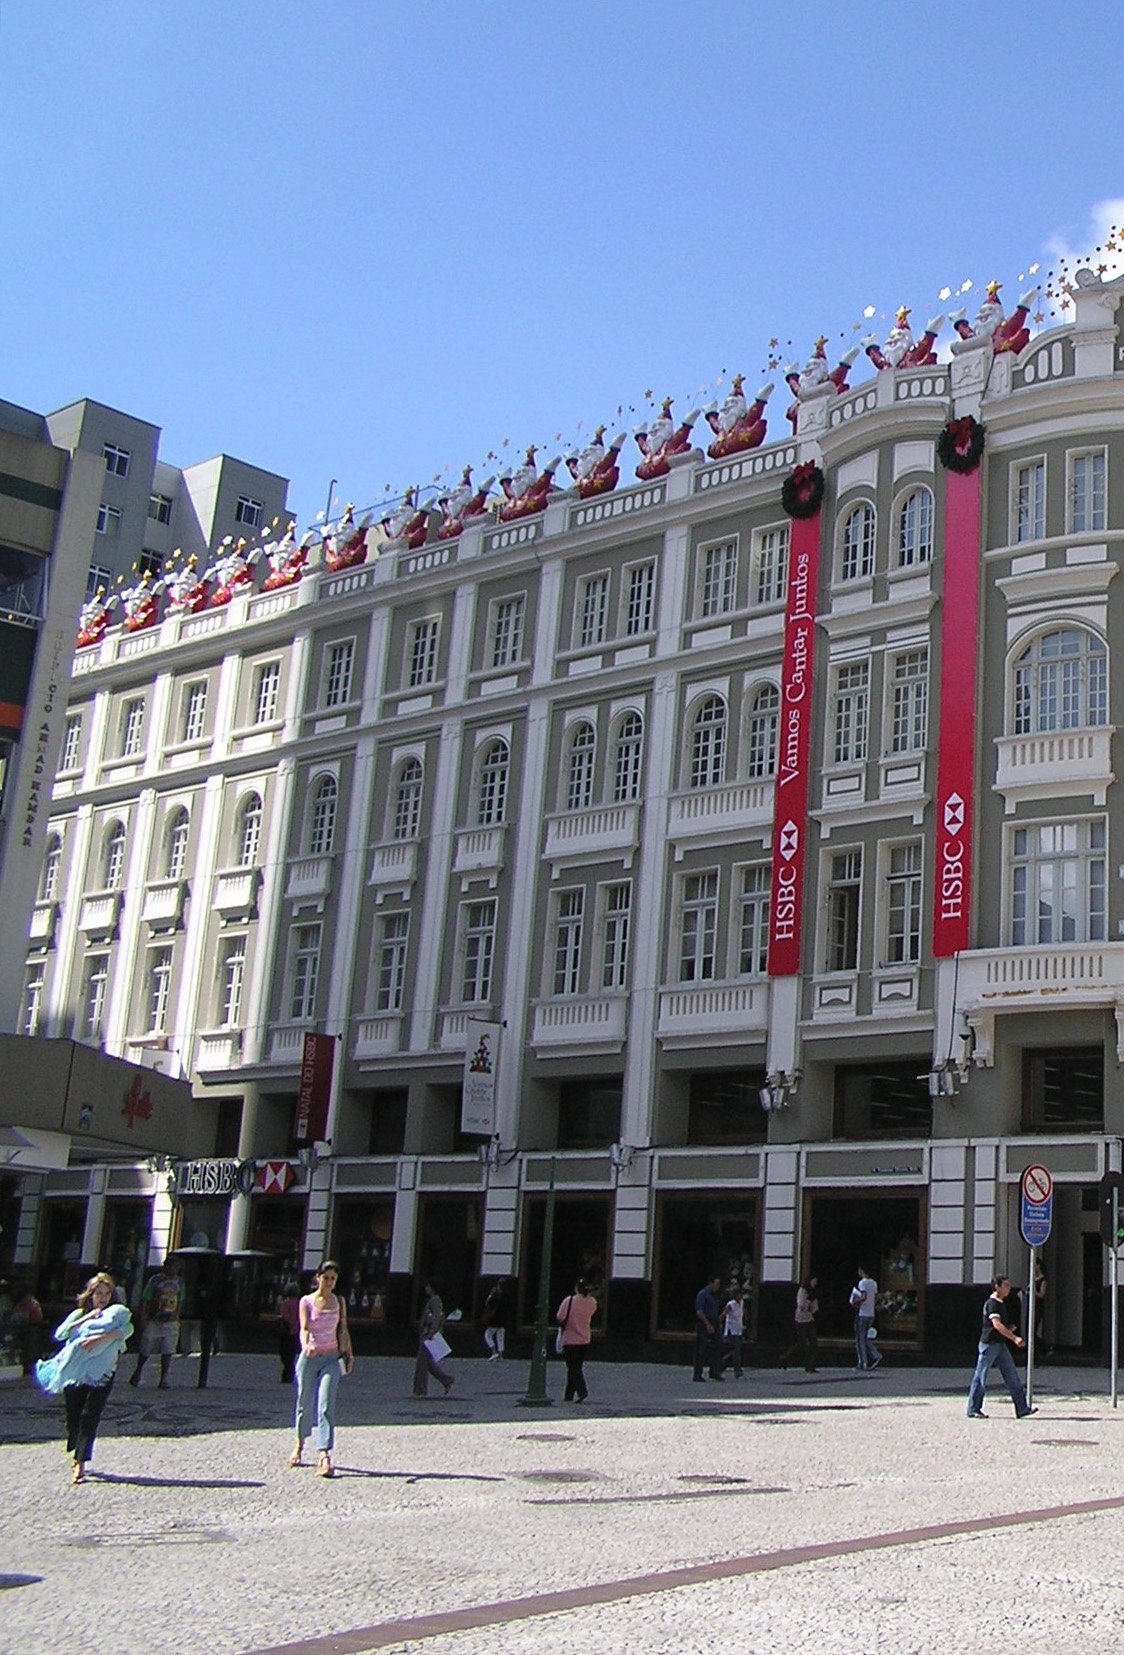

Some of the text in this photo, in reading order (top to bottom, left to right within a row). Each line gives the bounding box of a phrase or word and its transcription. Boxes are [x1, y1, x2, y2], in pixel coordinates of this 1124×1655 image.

[780, 553, 813, 787] Vamos Cantar Juntos
[775, 865, 797, 941] HSBC
[941, 839, 964, 920] HSBC
[299, 1036, 317, 1120] NATAL DO HSBC
[184, 1157, 255, 1196] HSBC
